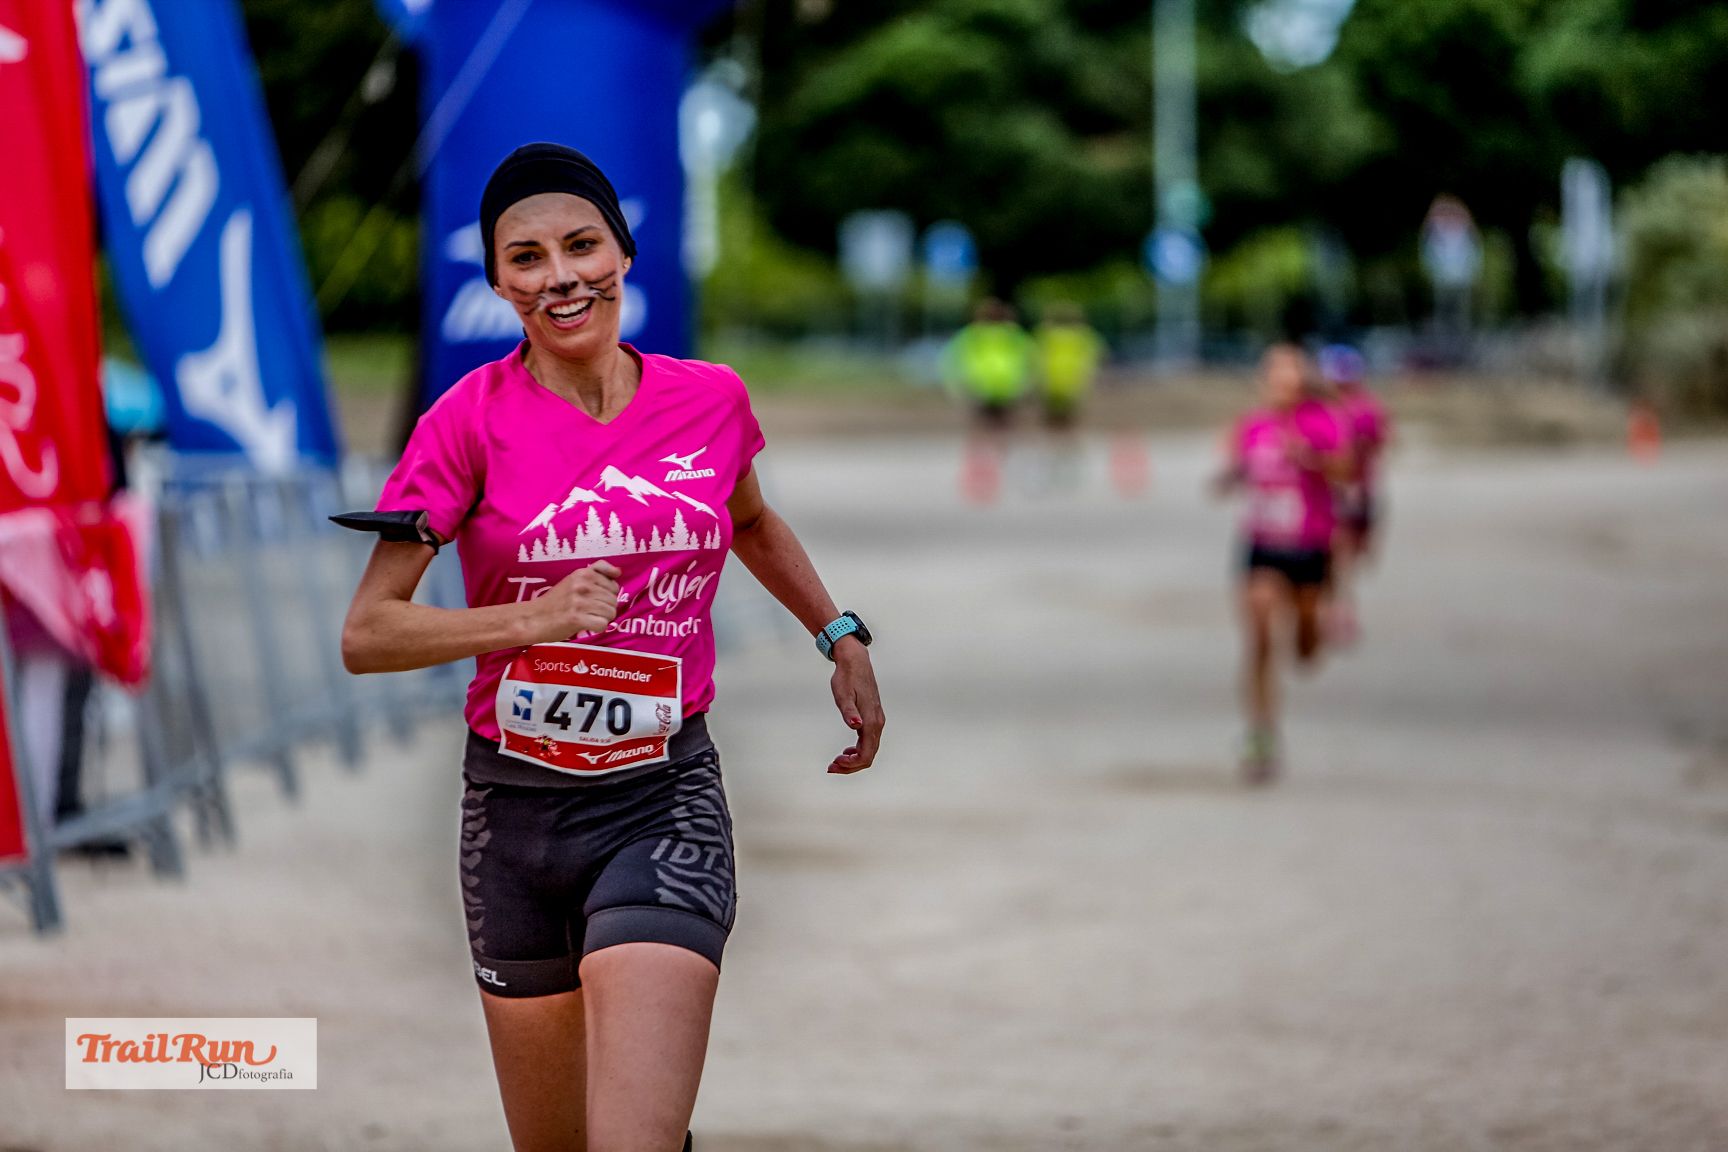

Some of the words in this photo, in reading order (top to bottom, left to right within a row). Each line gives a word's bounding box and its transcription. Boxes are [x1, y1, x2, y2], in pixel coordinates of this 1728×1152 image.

[534, 658, 571, 673] Sports
[589, 664, 652, 683] Santander
[544, 690, 632, 736] 470
